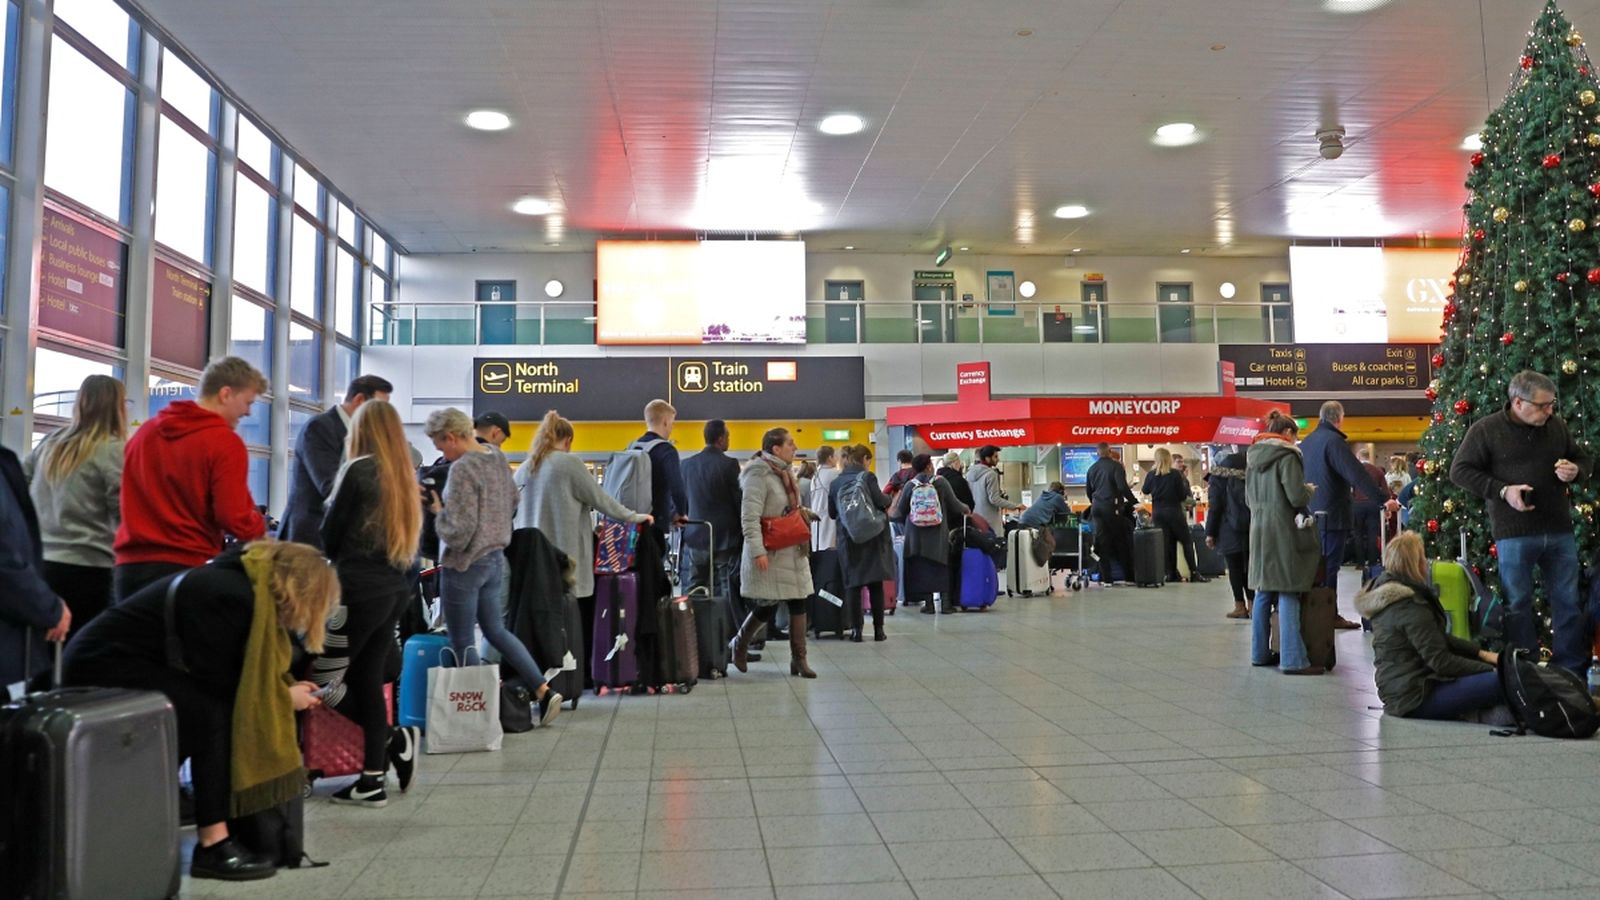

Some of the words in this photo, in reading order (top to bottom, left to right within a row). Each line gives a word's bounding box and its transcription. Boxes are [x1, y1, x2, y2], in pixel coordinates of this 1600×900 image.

[50, 216, 75, 236] Arrivals
[49, 233, 67, 252] Local
[68, 242, 88, 261] public
[89, 249, 106, 267] buses
[49, 252, 76, 273] Business
[48, 272, 66, 289] Hotel
[47, 295, 65, 311] Hotel
[1269, 348, 1293, 358] Taxis
[1386, 348, 1403, 358] Exit
[515, 361, 559, 377] North
[712, 361, 748, 376] Train
[1249, 362, 1265, 372] Car
[1267, 361, 1294, 372] rental
[1331, 361, 1358, 372] Buses
[1359, 361, 1367, 372] &
[1367, 361, 1404, 372] coaches
[960, 370, 986, 378] Currency
[514, 378, 579, 394] Terminal
[712, 378, 763, 393] station
[960, 377, 986, 385] Exchange
[1265, 376, 1295, 386] Hotels
[1351, 375, 1364, 386] All
[1365, 377, 1380, 386] car
[1380, 375, 1405, 387] parks
[1088, 400, 1181, 415] MONEYCORP
[929, 430, 974, 441] Currency
[975, 427, 1026, 439] Exchange
[1071, 425, 1124, 436] Currency
[1126, 424, 1180, 436] Exchange
[449, 691, 484, 701] SNOW
[456, 701, 487, 712] ROCK
